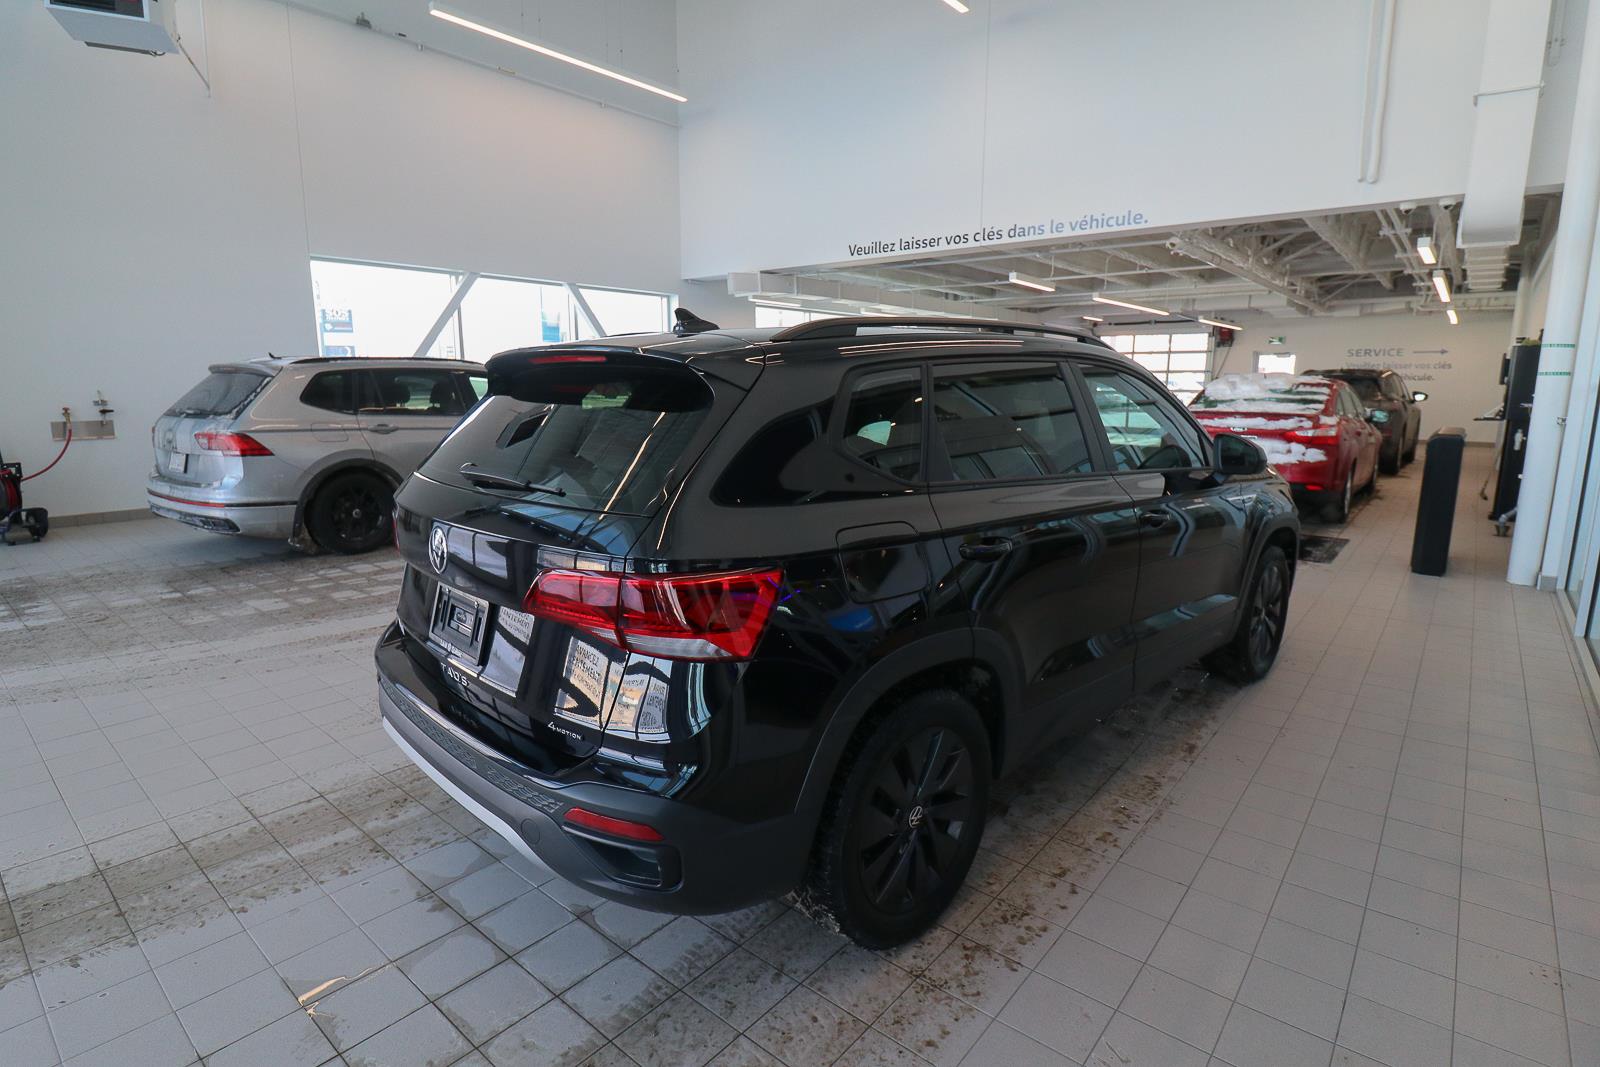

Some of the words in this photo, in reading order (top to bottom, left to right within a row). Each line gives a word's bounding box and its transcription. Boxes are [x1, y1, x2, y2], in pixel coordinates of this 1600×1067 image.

[848, 241, 896, 257] Veuillez
[899, 236, 942, 251] laisser
[945, 233, 969, 246] vos
[973, 226, 1003, 243] clés
[1007, 224, 1045, 239] dans
[1050, 219, 1065, 234] le
[1069, 210, 1149, 232] véhicule.
[1346, 347, 1406, 358] SERVICE
[1433, 361, 1453, 370] clés
[440, 661, 470, 686] TAOS
